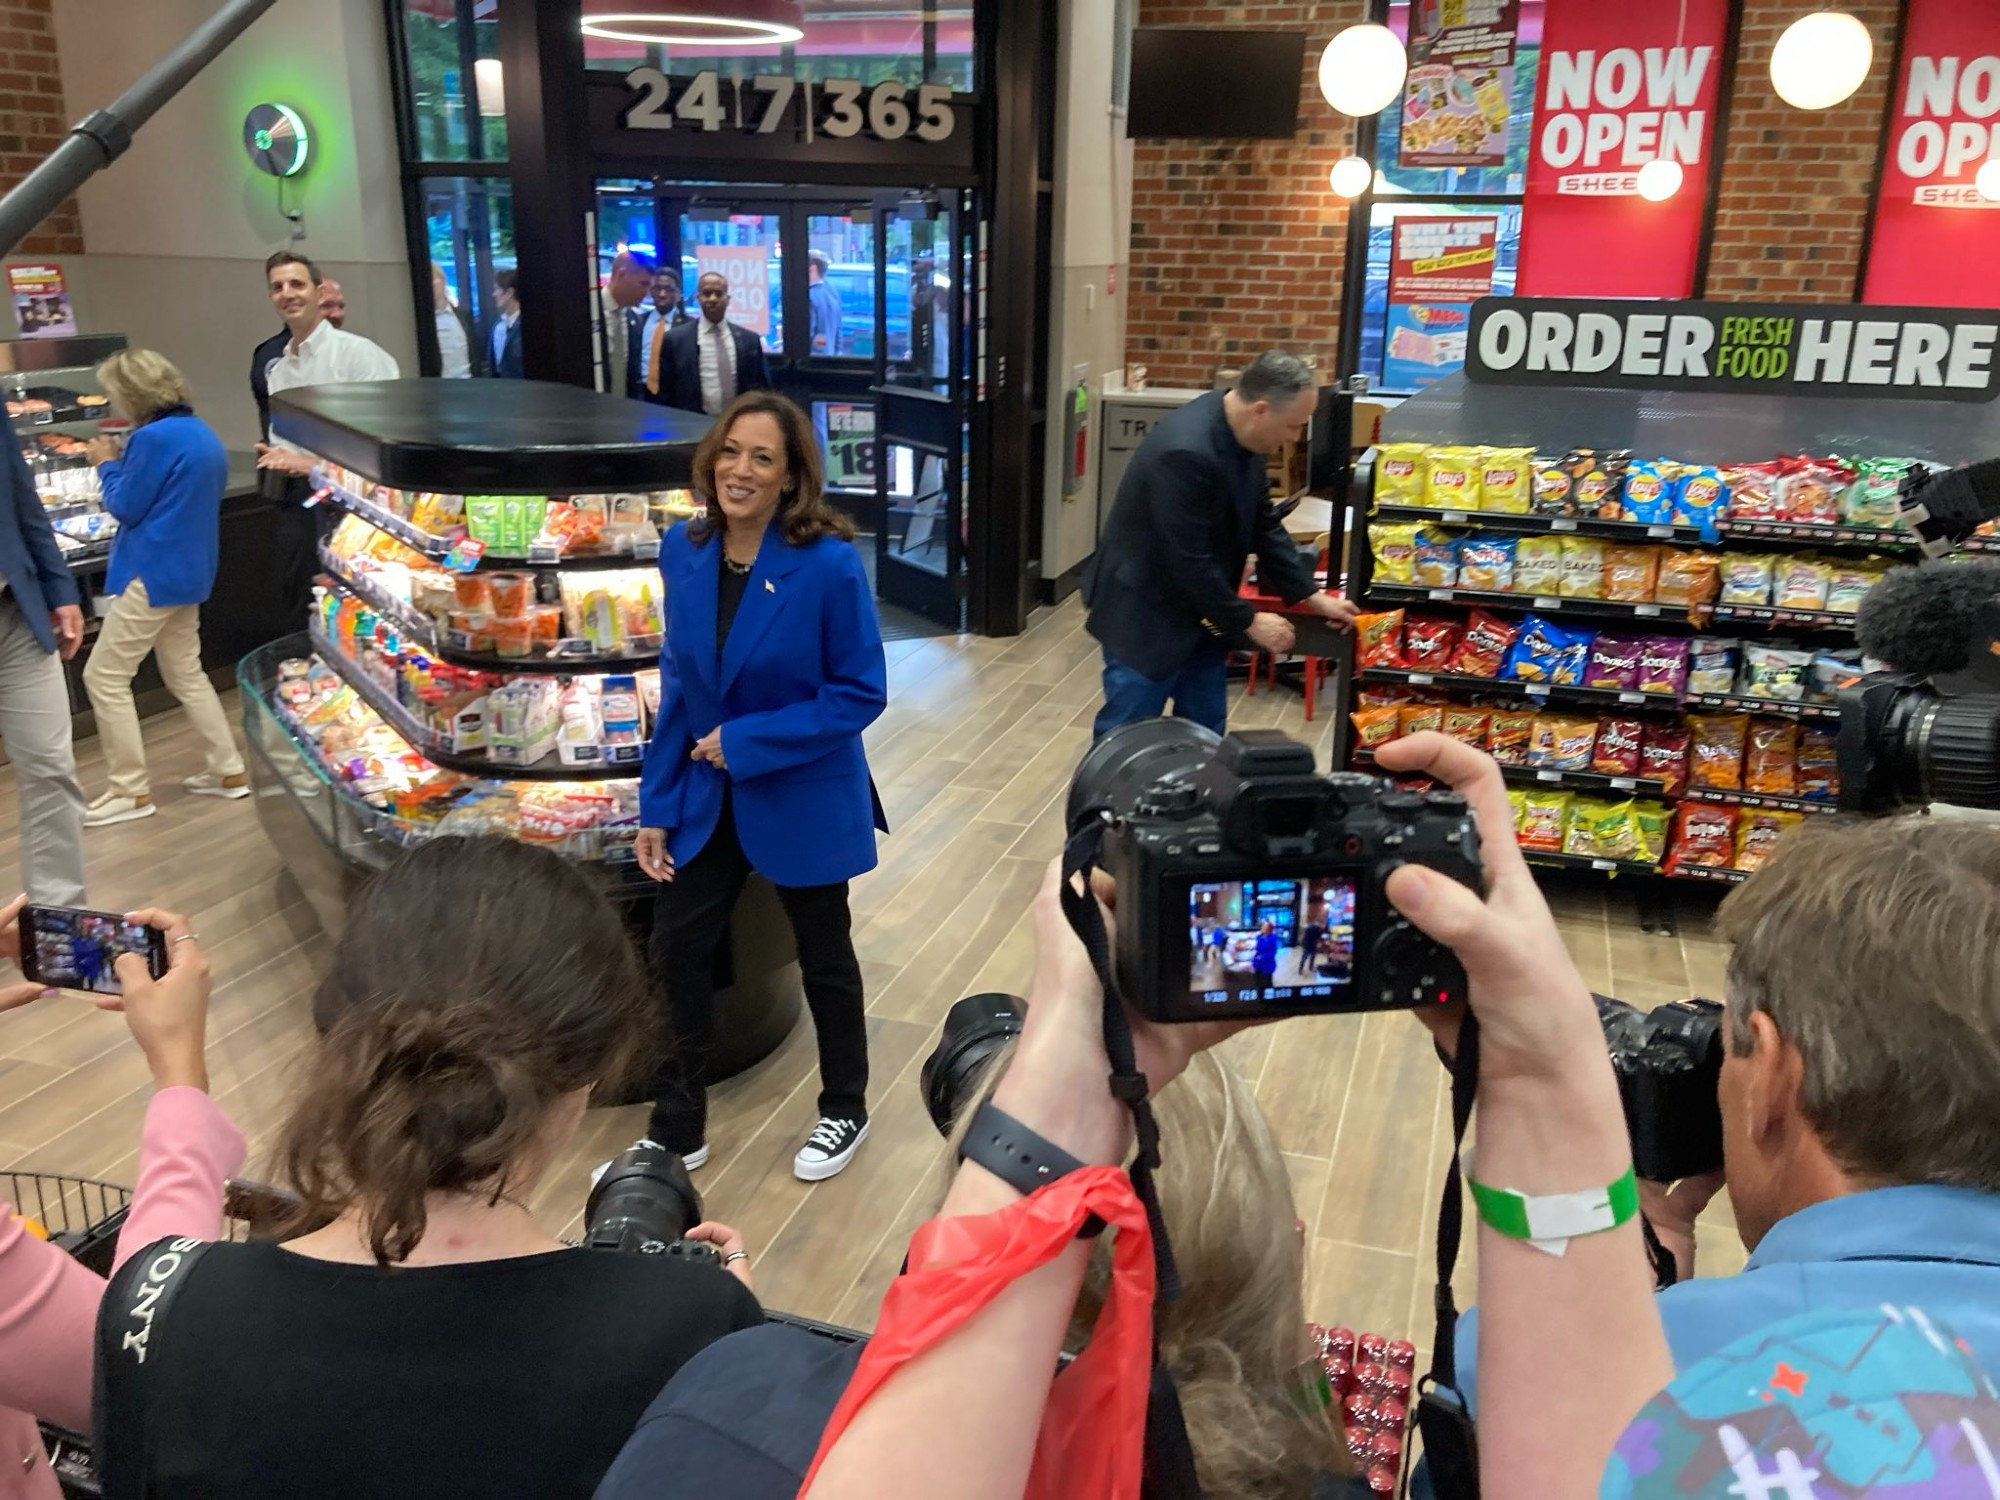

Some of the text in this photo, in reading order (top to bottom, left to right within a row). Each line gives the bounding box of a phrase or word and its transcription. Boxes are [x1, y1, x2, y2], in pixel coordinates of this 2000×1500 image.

[625, 67, 956, 142] 24 7 365
[1544, 46, 1713, 110] NOW
[1904, 56, 2000, 118] NO
[1540, 110, 1706, 168] OPEN
[1565, 178, 1638, 191] SHEE
[1479, 308, 2000, 389] ORDER HERE
[1720, 316, 1795, 346] FRESH
[1715, 346, 1789, 379] FOOD
